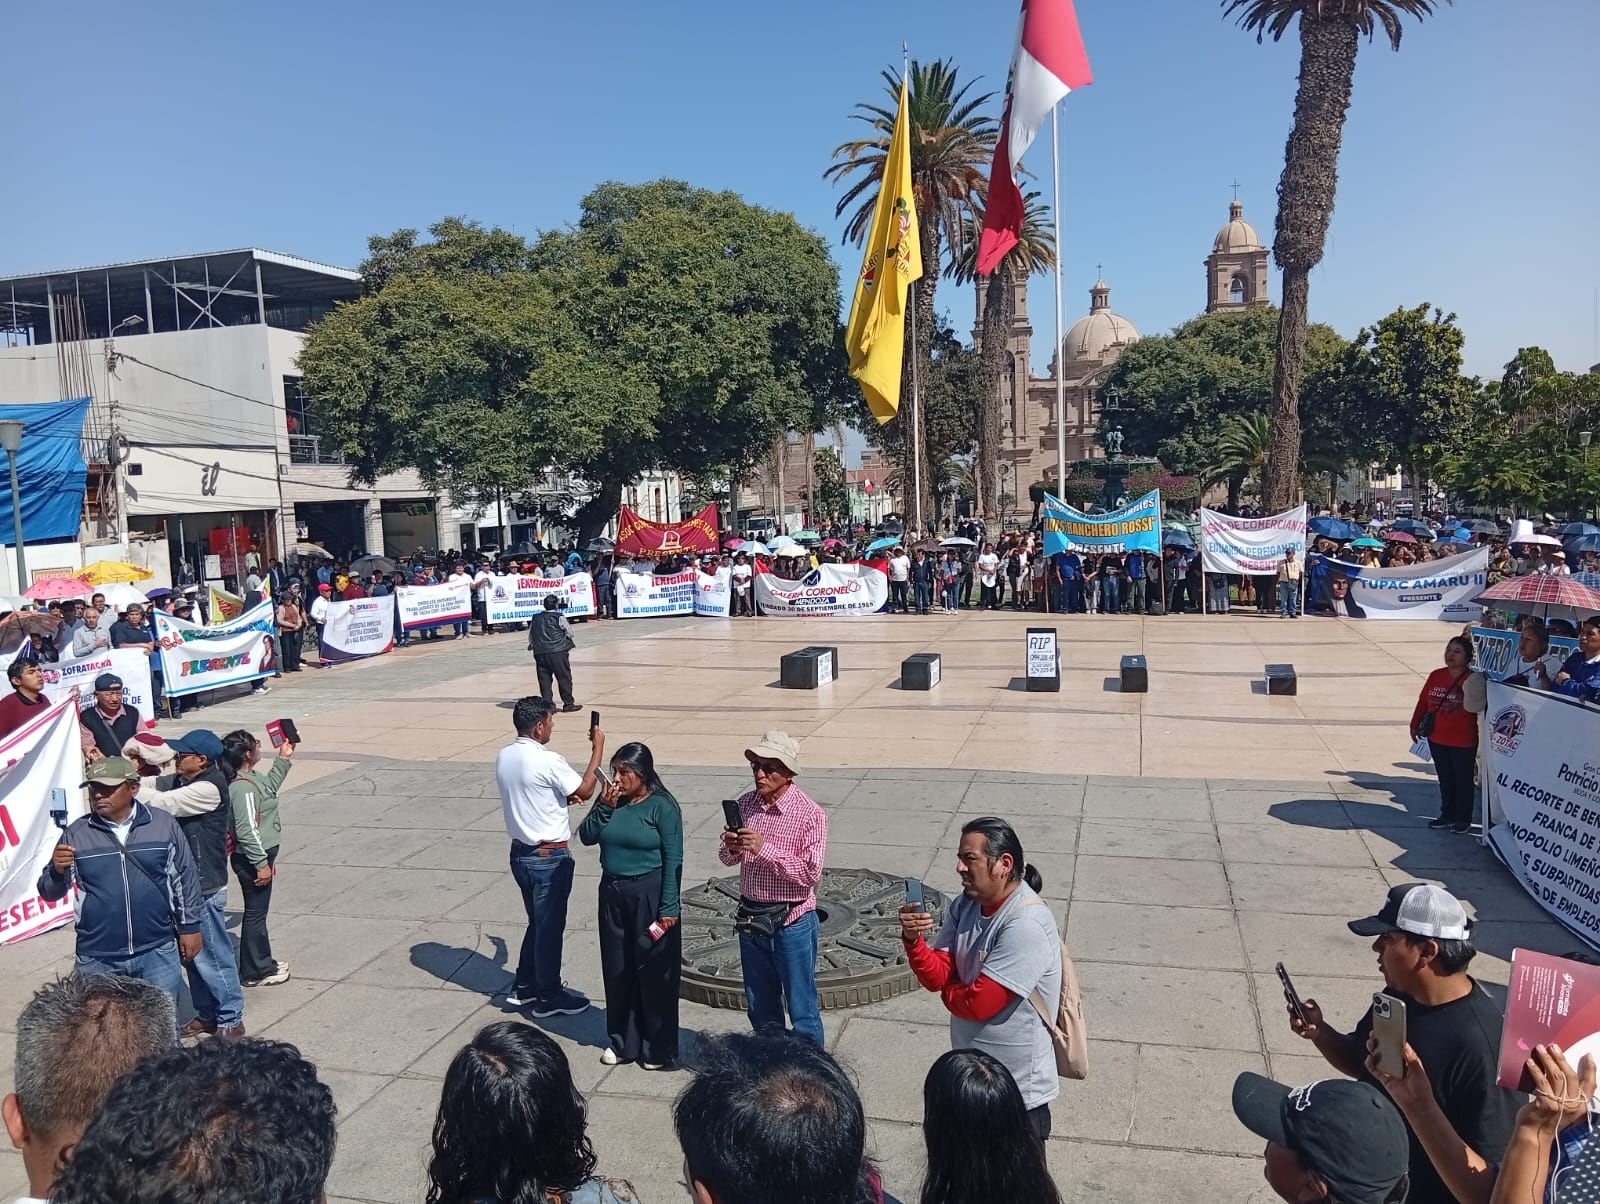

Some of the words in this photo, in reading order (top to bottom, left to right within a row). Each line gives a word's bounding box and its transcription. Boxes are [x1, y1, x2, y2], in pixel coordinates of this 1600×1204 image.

[1068, 541, 1126, 554] PRESENTE
[1237, 559, 1277, 571] PRESENT
[518, 578, 564, 590] ¡EXIGIMOS!
[1360, 578, 1409, 590] TUPAC
[1413, 575, 1469, 589] AMARU
[1474, 573, 1483, 585] II
[771, 589, 804, 599] GALERIA
[806, 586, 849, 597] CORONEL
[795, 597, 829, 605] MENDOZA
[806, 603, 846, 612] SEPTIEMBRE
[1030, 637, 1051, 649] RIP
[180, 652, 251, 676] PRESENTE
[1496, 736, 1518, 750] ZOTAC
[1557, 763, 1599, 793] Patricio
[1496, 772, 1509, 788] AL
[1510, 778, 1565, 812] RECORTE
[1563, 800, 1580, 818] DE
[1532, 811, 1578, 843] FRANCA
[1579, 832, 1596, 850] DE
[1507, 821, 1562, 858] NOPOLIO
[1531, 858, 1600, 905] SUBPARTIDAS
[1542, 886, 1558, 905] DE
